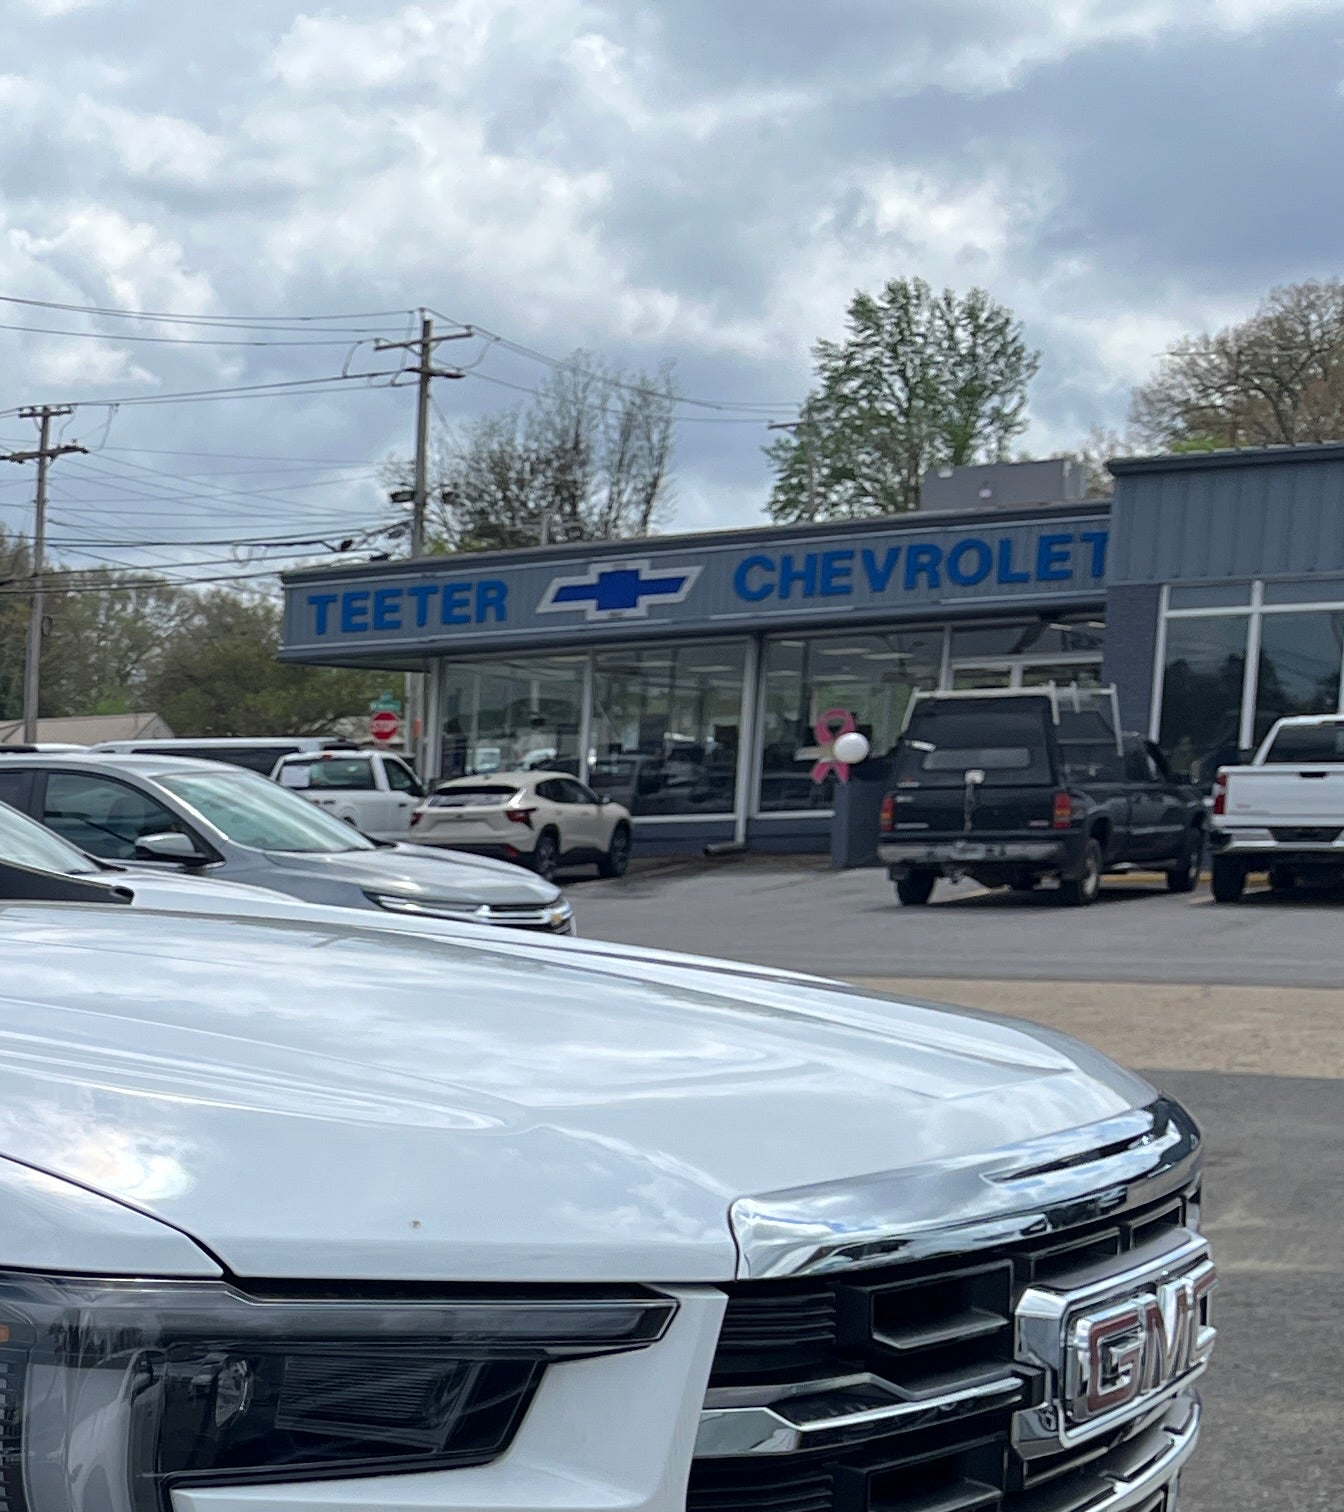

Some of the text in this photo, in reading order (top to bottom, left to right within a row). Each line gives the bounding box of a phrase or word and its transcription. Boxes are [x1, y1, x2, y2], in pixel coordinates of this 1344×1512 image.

[307, 531, 1110, 636] TEETER CHEVROLET
[1075, 1259, 1218, 1417] GMC
